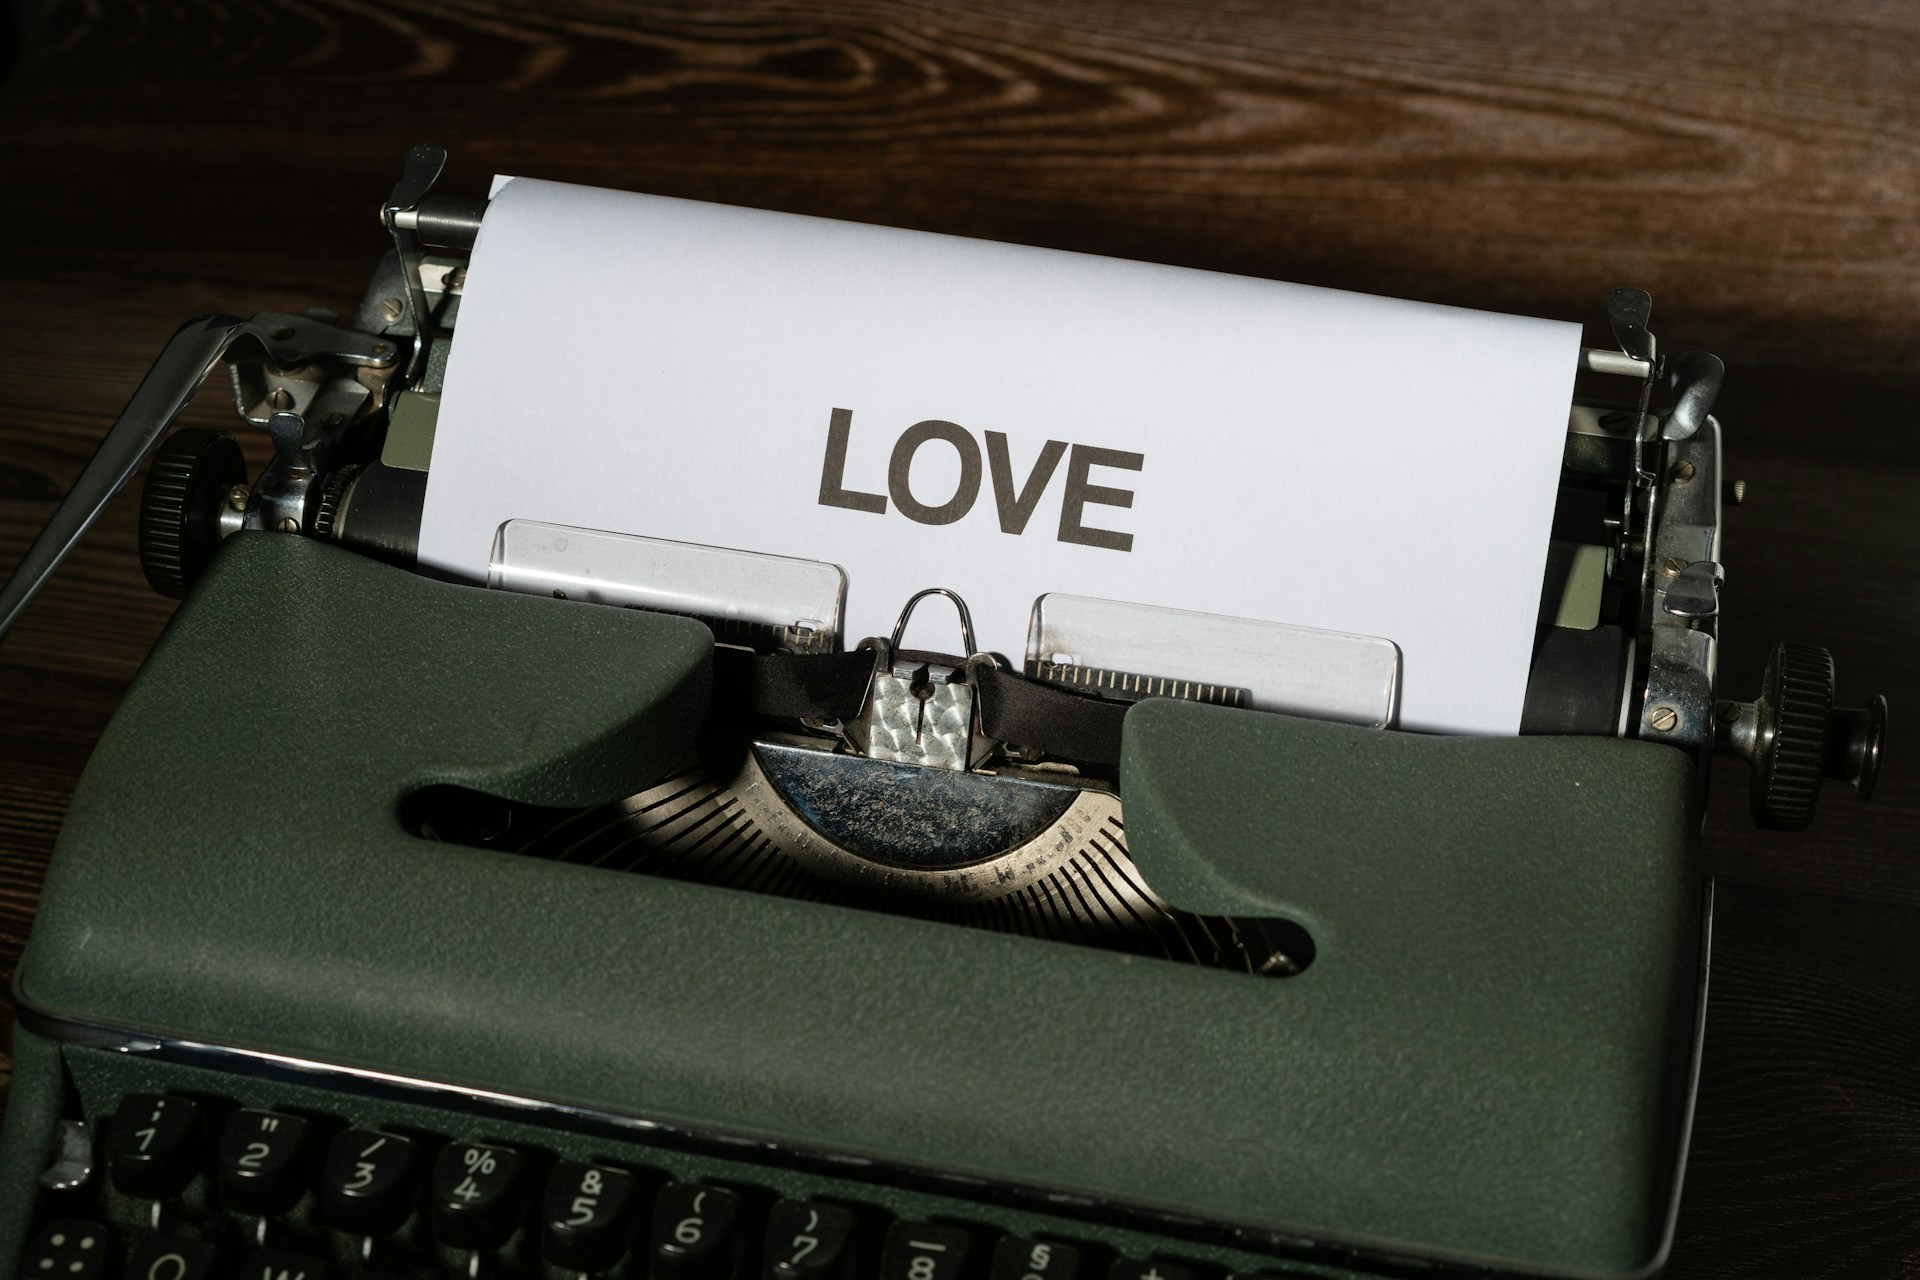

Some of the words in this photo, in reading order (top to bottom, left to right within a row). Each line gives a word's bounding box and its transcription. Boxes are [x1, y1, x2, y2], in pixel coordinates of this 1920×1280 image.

[818, 407, 1144, 552] LOVE
[134, 1127, 156, 1152] 1
[238, 1142, 271, 1167] 2
[464, 1149, 496, 1174] %
[344, 1162, 374, 1189] 3
[581, 1170, 602, 1196] &
[453, 1176, 481, 1201] 4
[566, 1197, 597, 1226] 5
[693, 1191, 706, 1214] (
[675, 1217, 705, 1244] 6
[804, 1209, 818, 1232] )
[791, 1235, 819, 1265] 7
[907, 1256, 936, 1280] 8
